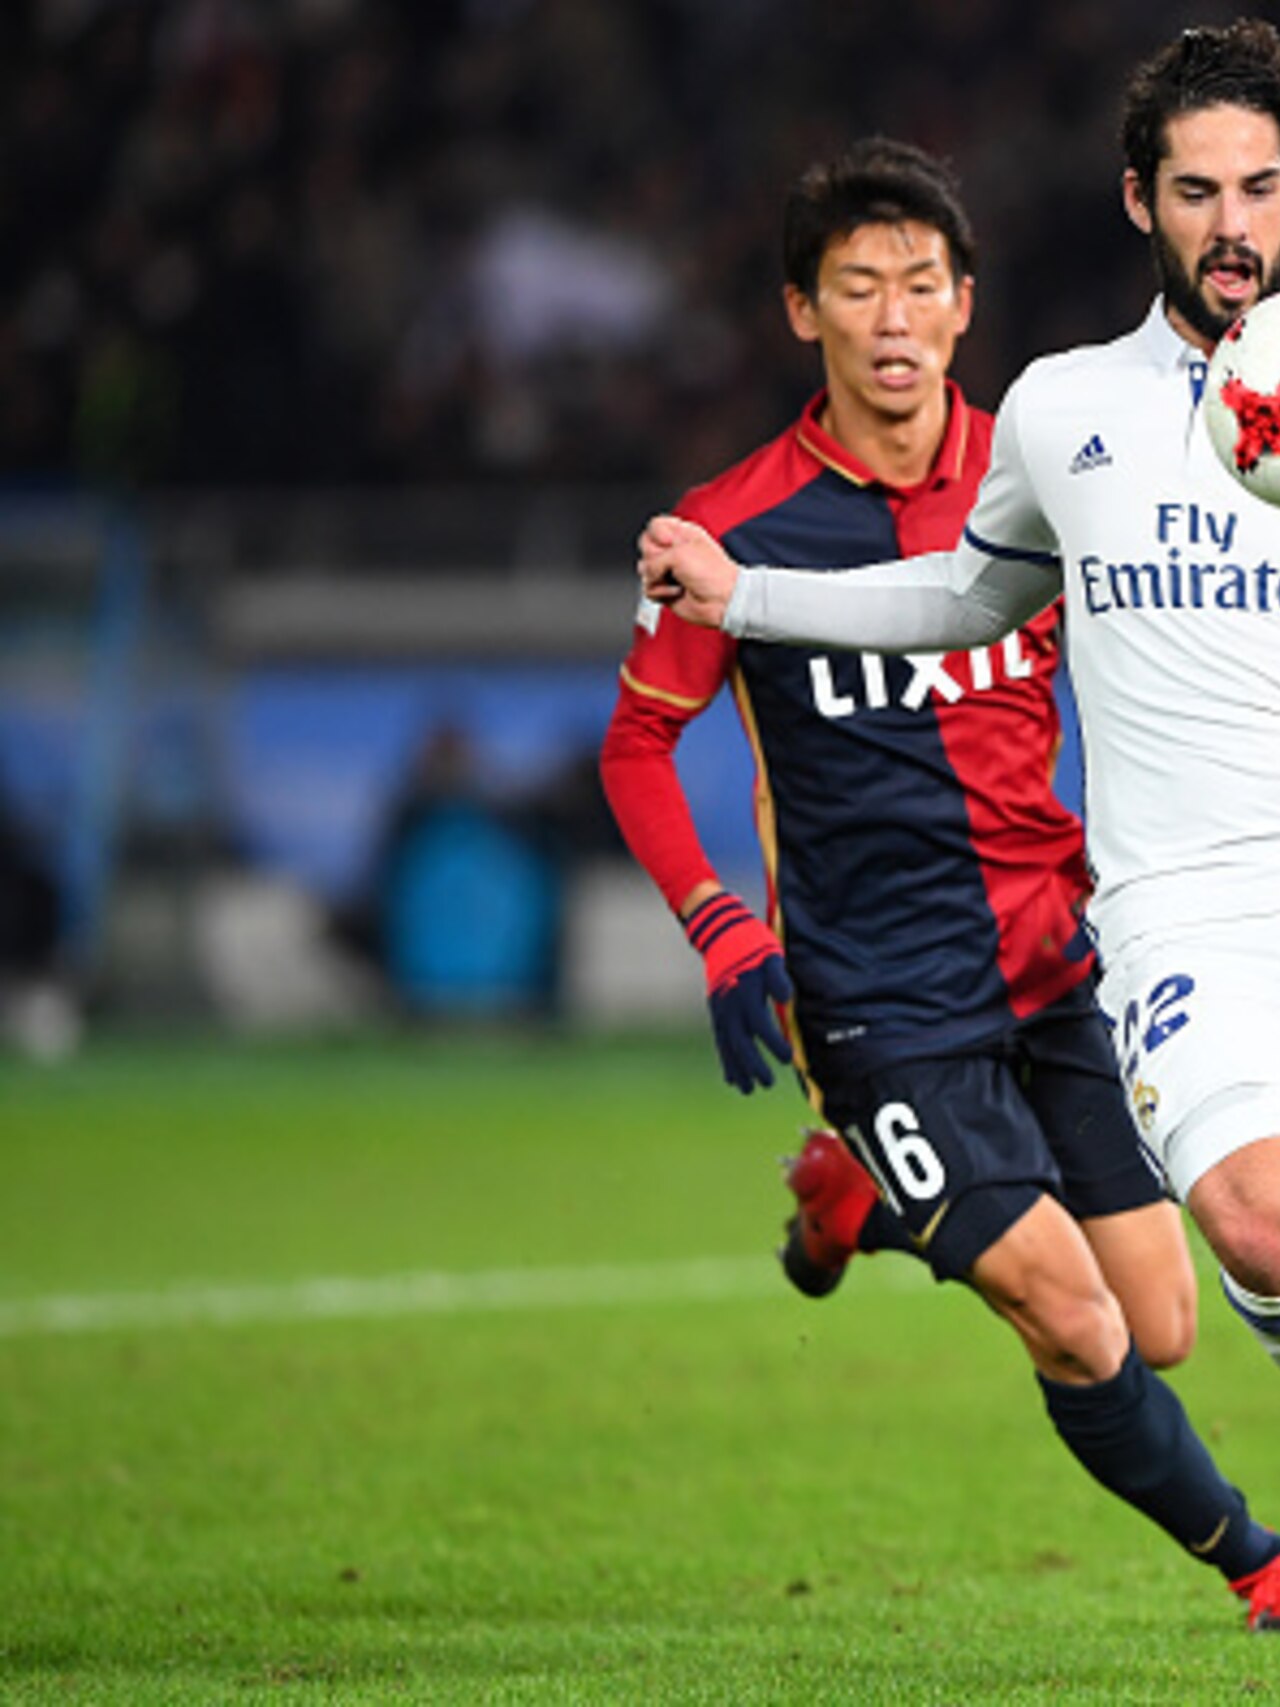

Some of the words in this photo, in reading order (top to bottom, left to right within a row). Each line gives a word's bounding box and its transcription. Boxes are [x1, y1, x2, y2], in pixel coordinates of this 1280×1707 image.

[1156, 503, 1238, 552] Fly
[809, 629, 1034, 719] LIXIL
[847, 1102, 946, 1217] 16
